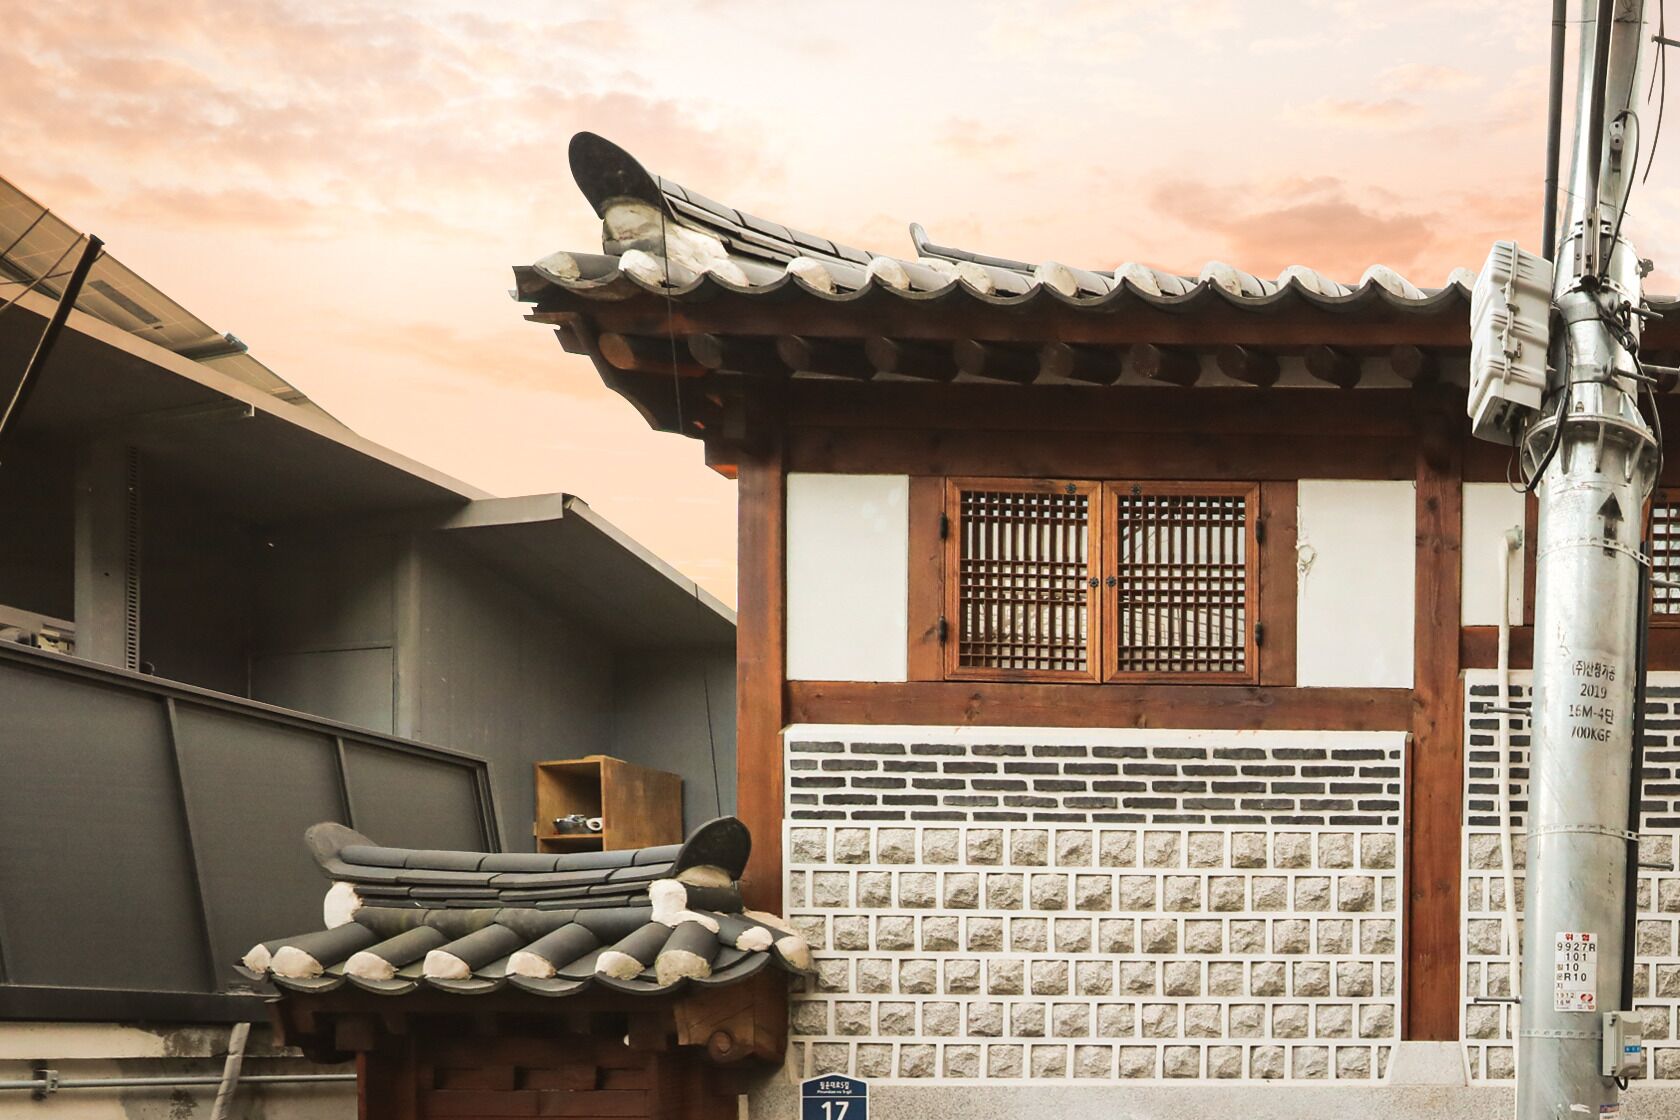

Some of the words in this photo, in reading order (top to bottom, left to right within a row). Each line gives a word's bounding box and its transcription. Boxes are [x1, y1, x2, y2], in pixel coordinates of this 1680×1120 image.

[1580, 683, 1608, 699] 2019
[1557, 943, 1596, 952] 9927R
[1565, 952, 1587, 962] 101
